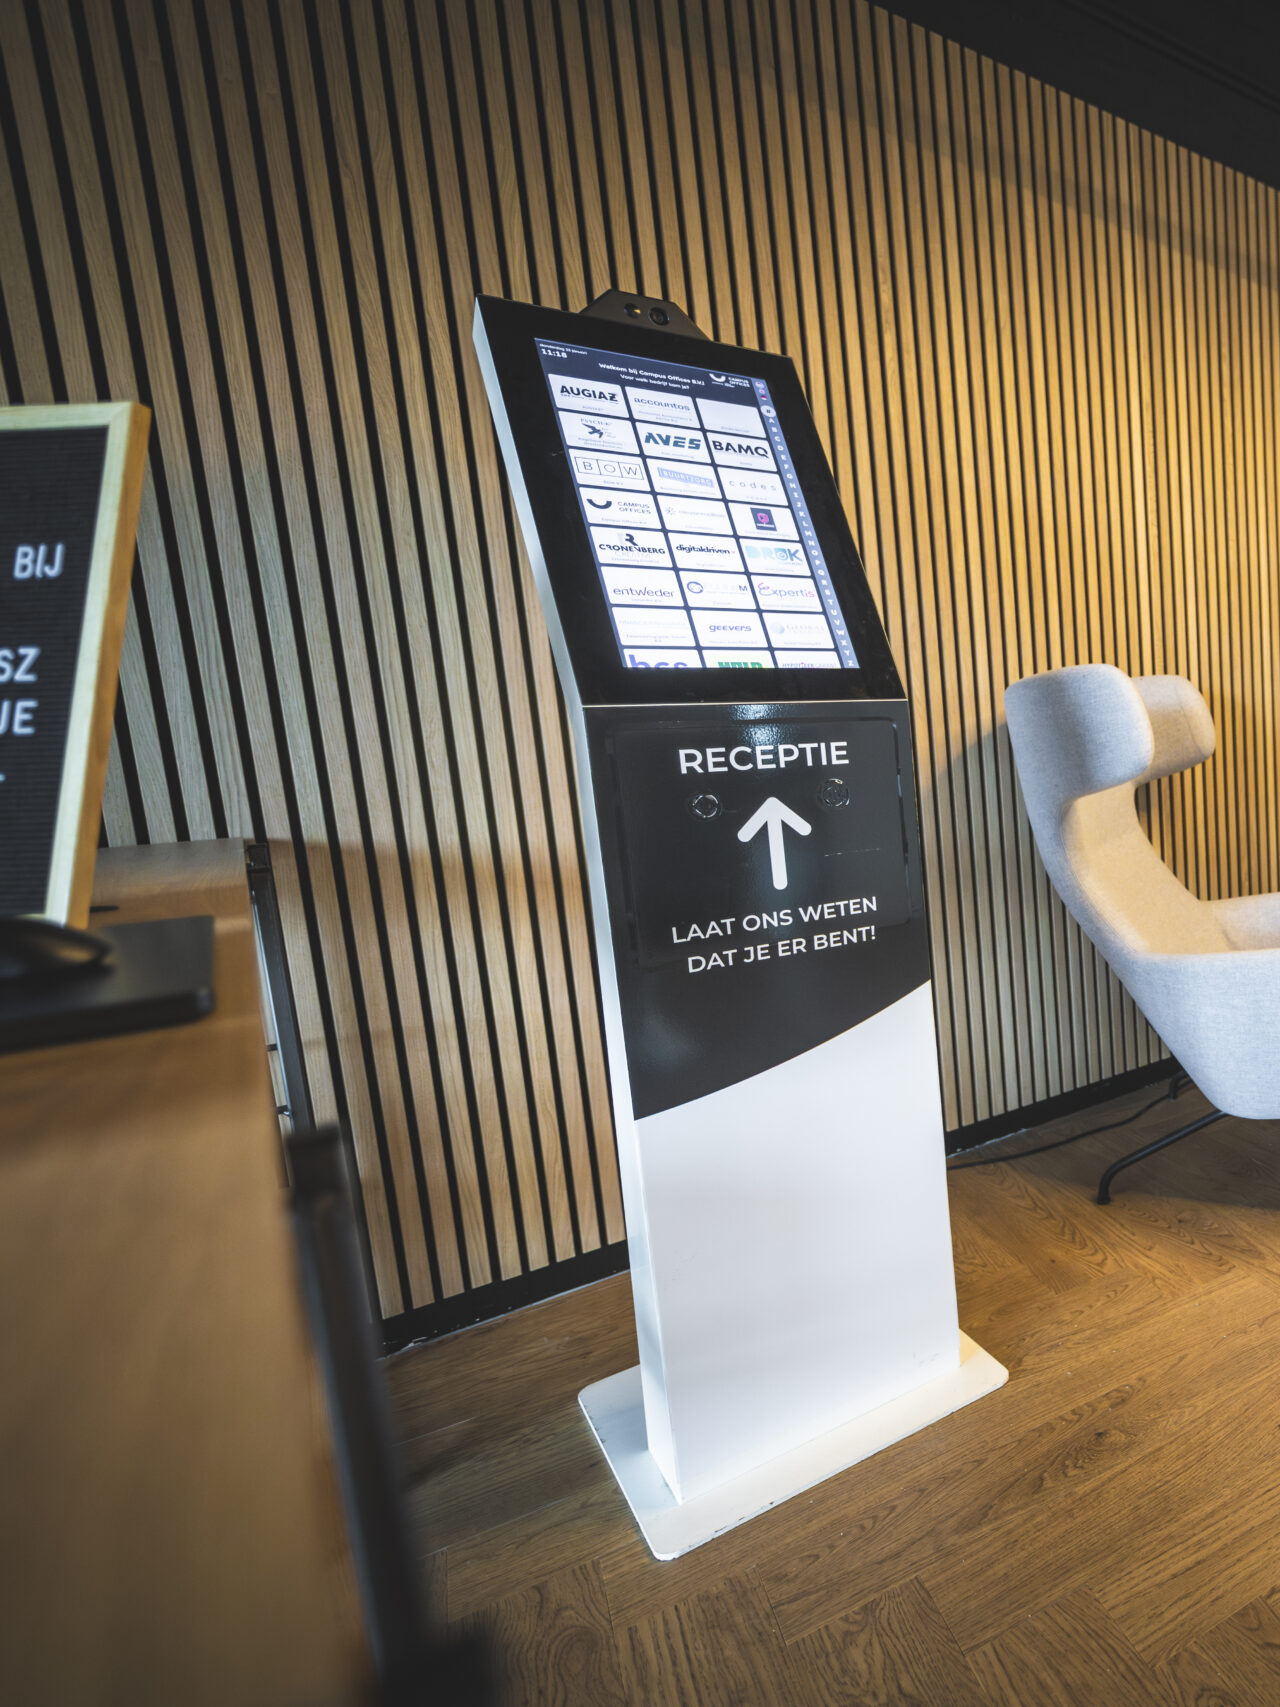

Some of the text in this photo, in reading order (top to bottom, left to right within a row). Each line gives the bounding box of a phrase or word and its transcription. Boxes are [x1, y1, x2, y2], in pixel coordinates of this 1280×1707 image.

[541, 348, 568, 358] 11:18
[598, 363, 627, 372] Welkom
[639, 370, 666, 379] Campus
[667, 375, 690, 383] Offices
[644, 432, 701, 450] AVES
[712, 440, 769, 458] BAMQ
[617, 501, 650, 509] CAMPUS
[619, 507, 651, 515] OFFICES
[14, 543, 65, 580] BIJ
[678, 741, 849, 775] RECEPTIE
[671, 896, 878, 944] LAAT ONS WETEN
[687, 925, 876, 974] DAT JE ER BENT!
